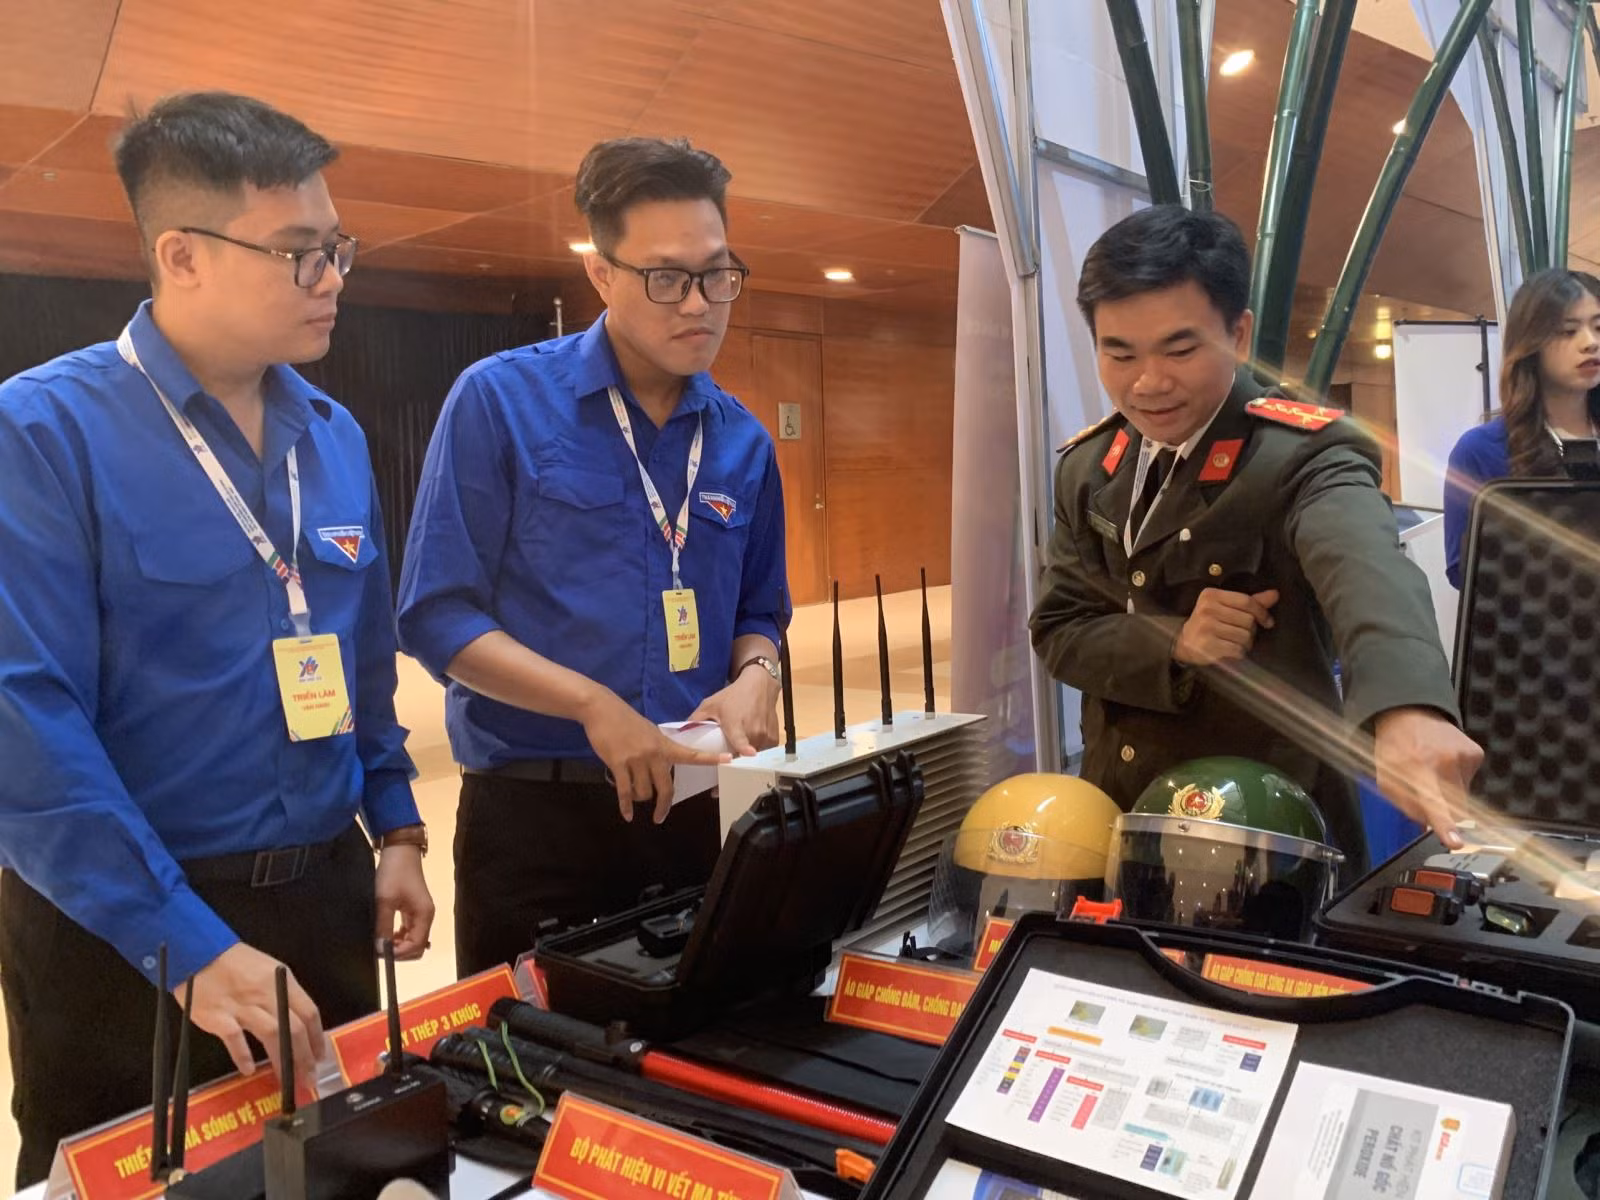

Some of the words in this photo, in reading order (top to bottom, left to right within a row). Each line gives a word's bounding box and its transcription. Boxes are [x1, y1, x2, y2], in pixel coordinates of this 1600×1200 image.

[844, 976, 857, 997] ÁO
[856, 980, 875, 1000] GIÁP
[875, 983, 902, 1006] CHỐNG
[922, 992, 951, 1016] CHỐNG
[410, 1018, 439, 1043] THÉP
[441, 1015, 450, 1031] 3
[451, 1002, 482, 1028] KHÚC
[114, 1143, 153, 1179] THIẾT
[201, 1112, 239, 1141] SÓNG
[237, 1104, 257, 1126] VỆ
[1353, 1127, 1380, 1179] PEROXIDE
[570, 1136, 591, 1165] BỘ
[588, 1143, 623, 1174] PHÁT
[620, 1155, 653, 1187] HIỆN
[651, 1162, 667, 1190] VI
[666, 1170, 693, 1200] VẾT
[690, 1180, 714, 1200] MA
